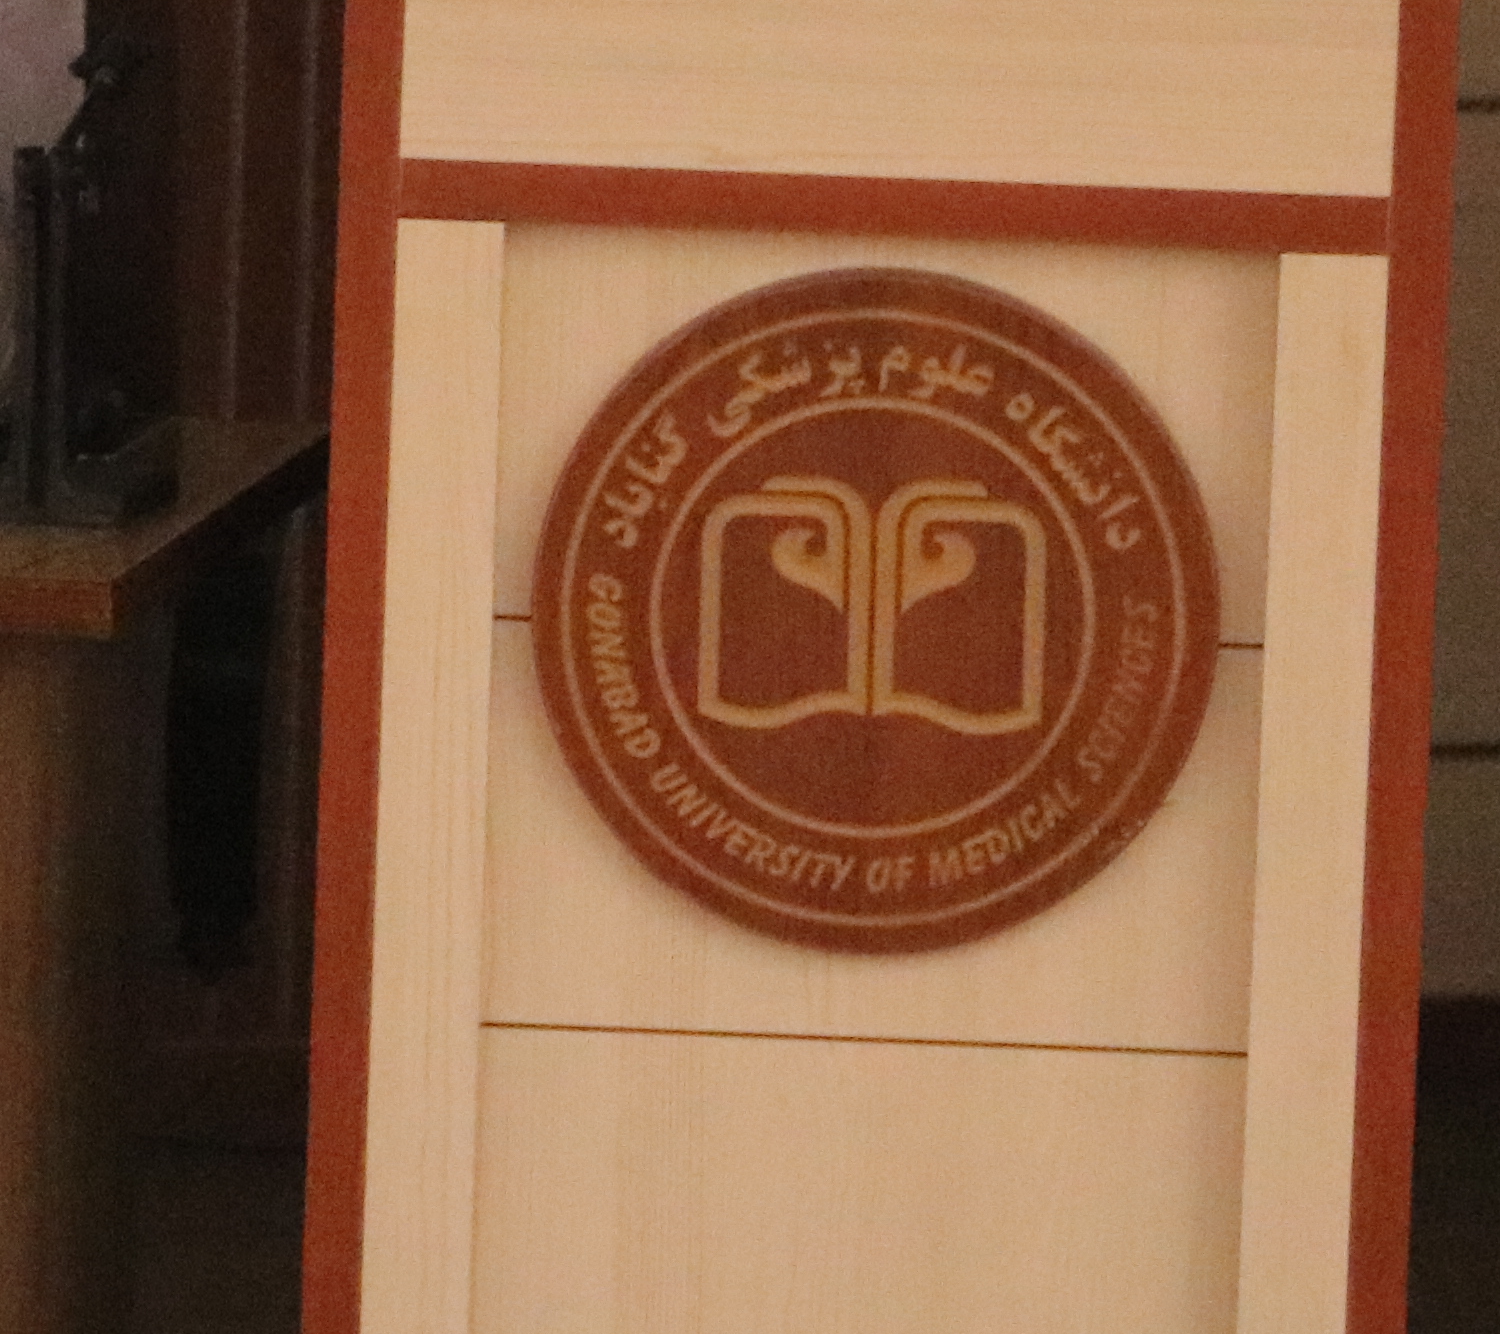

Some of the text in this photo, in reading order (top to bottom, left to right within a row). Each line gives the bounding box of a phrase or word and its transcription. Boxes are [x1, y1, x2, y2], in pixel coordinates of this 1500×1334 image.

[601, 338, 1142, 551] دانشگاه علوم پزشکی گناباد
[585, 571, 1158, 895] GONABAD UNIVERSITY OF MEDICAL SCIENCES
